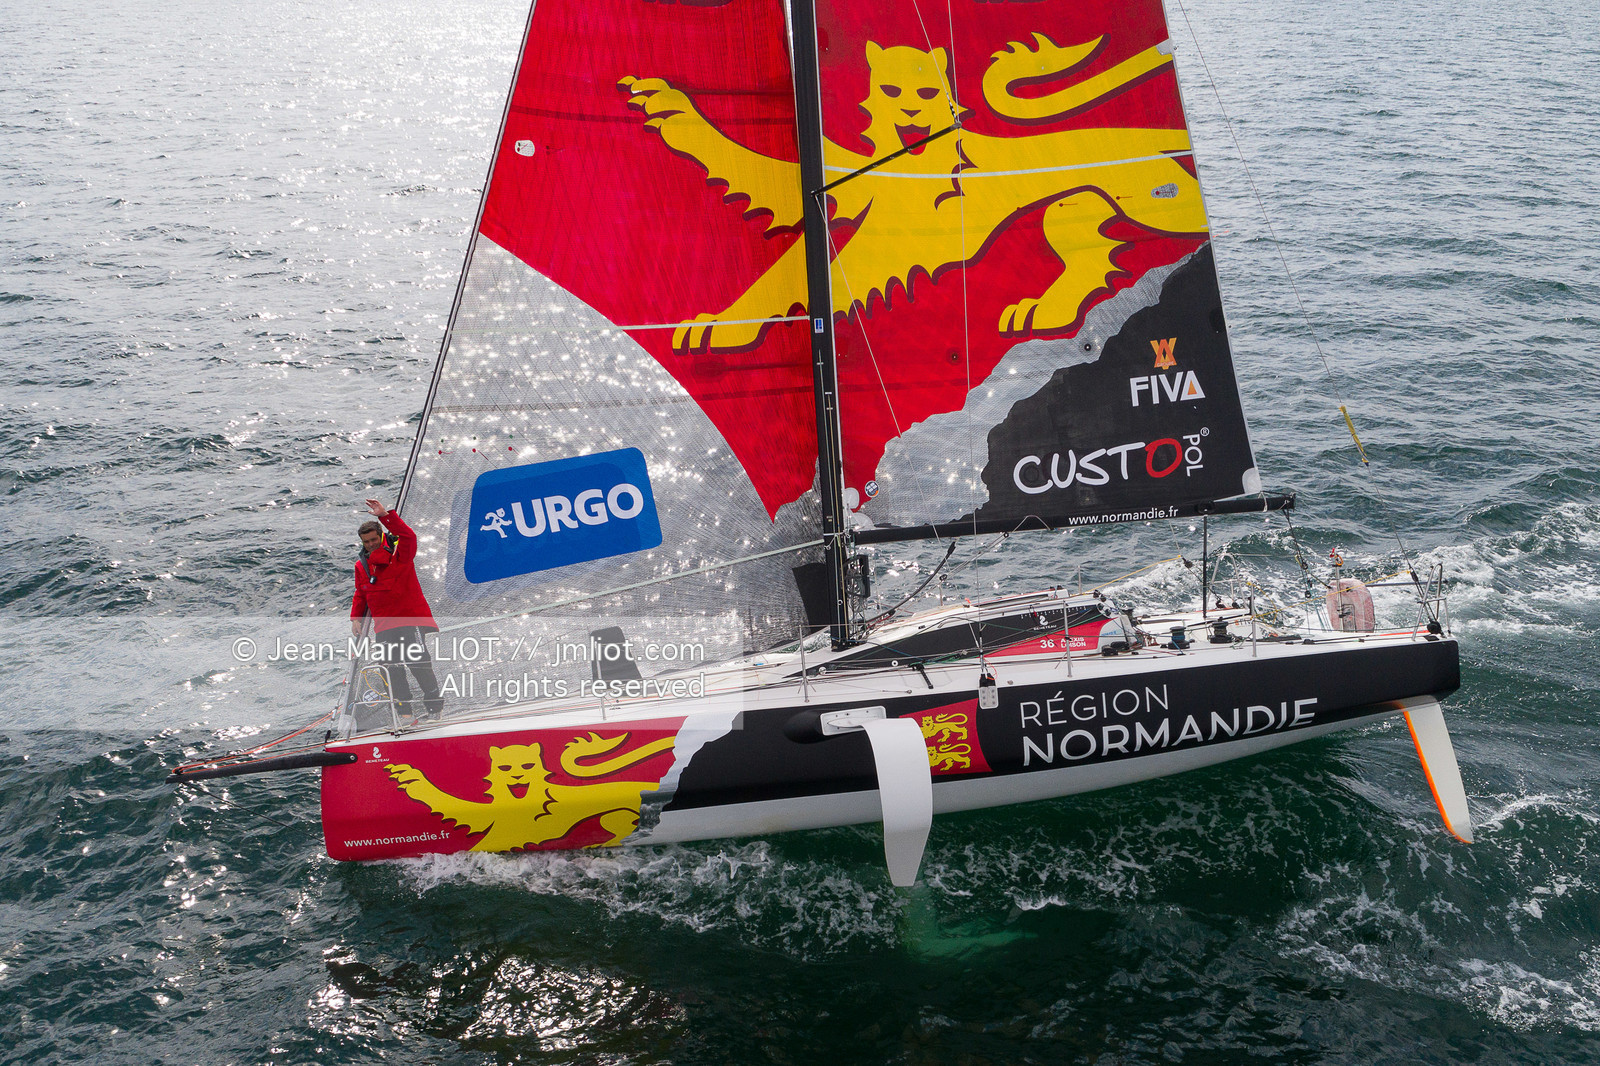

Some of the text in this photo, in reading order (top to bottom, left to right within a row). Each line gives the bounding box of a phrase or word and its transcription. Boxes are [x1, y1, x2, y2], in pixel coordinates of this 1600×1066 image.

[1130, 370, 1206, 407] FIVA
[1013, 438, 1183, 494] CUSTO
[511, 483, 644, 538] URGO
[1068, 507, 1179, 525] www.normandie.fr
[1040, 639, 1055, 649] 36
[1019, 684, 1169, 729] RÉGION
[1022, 697, 1318, 766] NORMANDIE
[344, 830, 450, 848] www.normandie.fr
